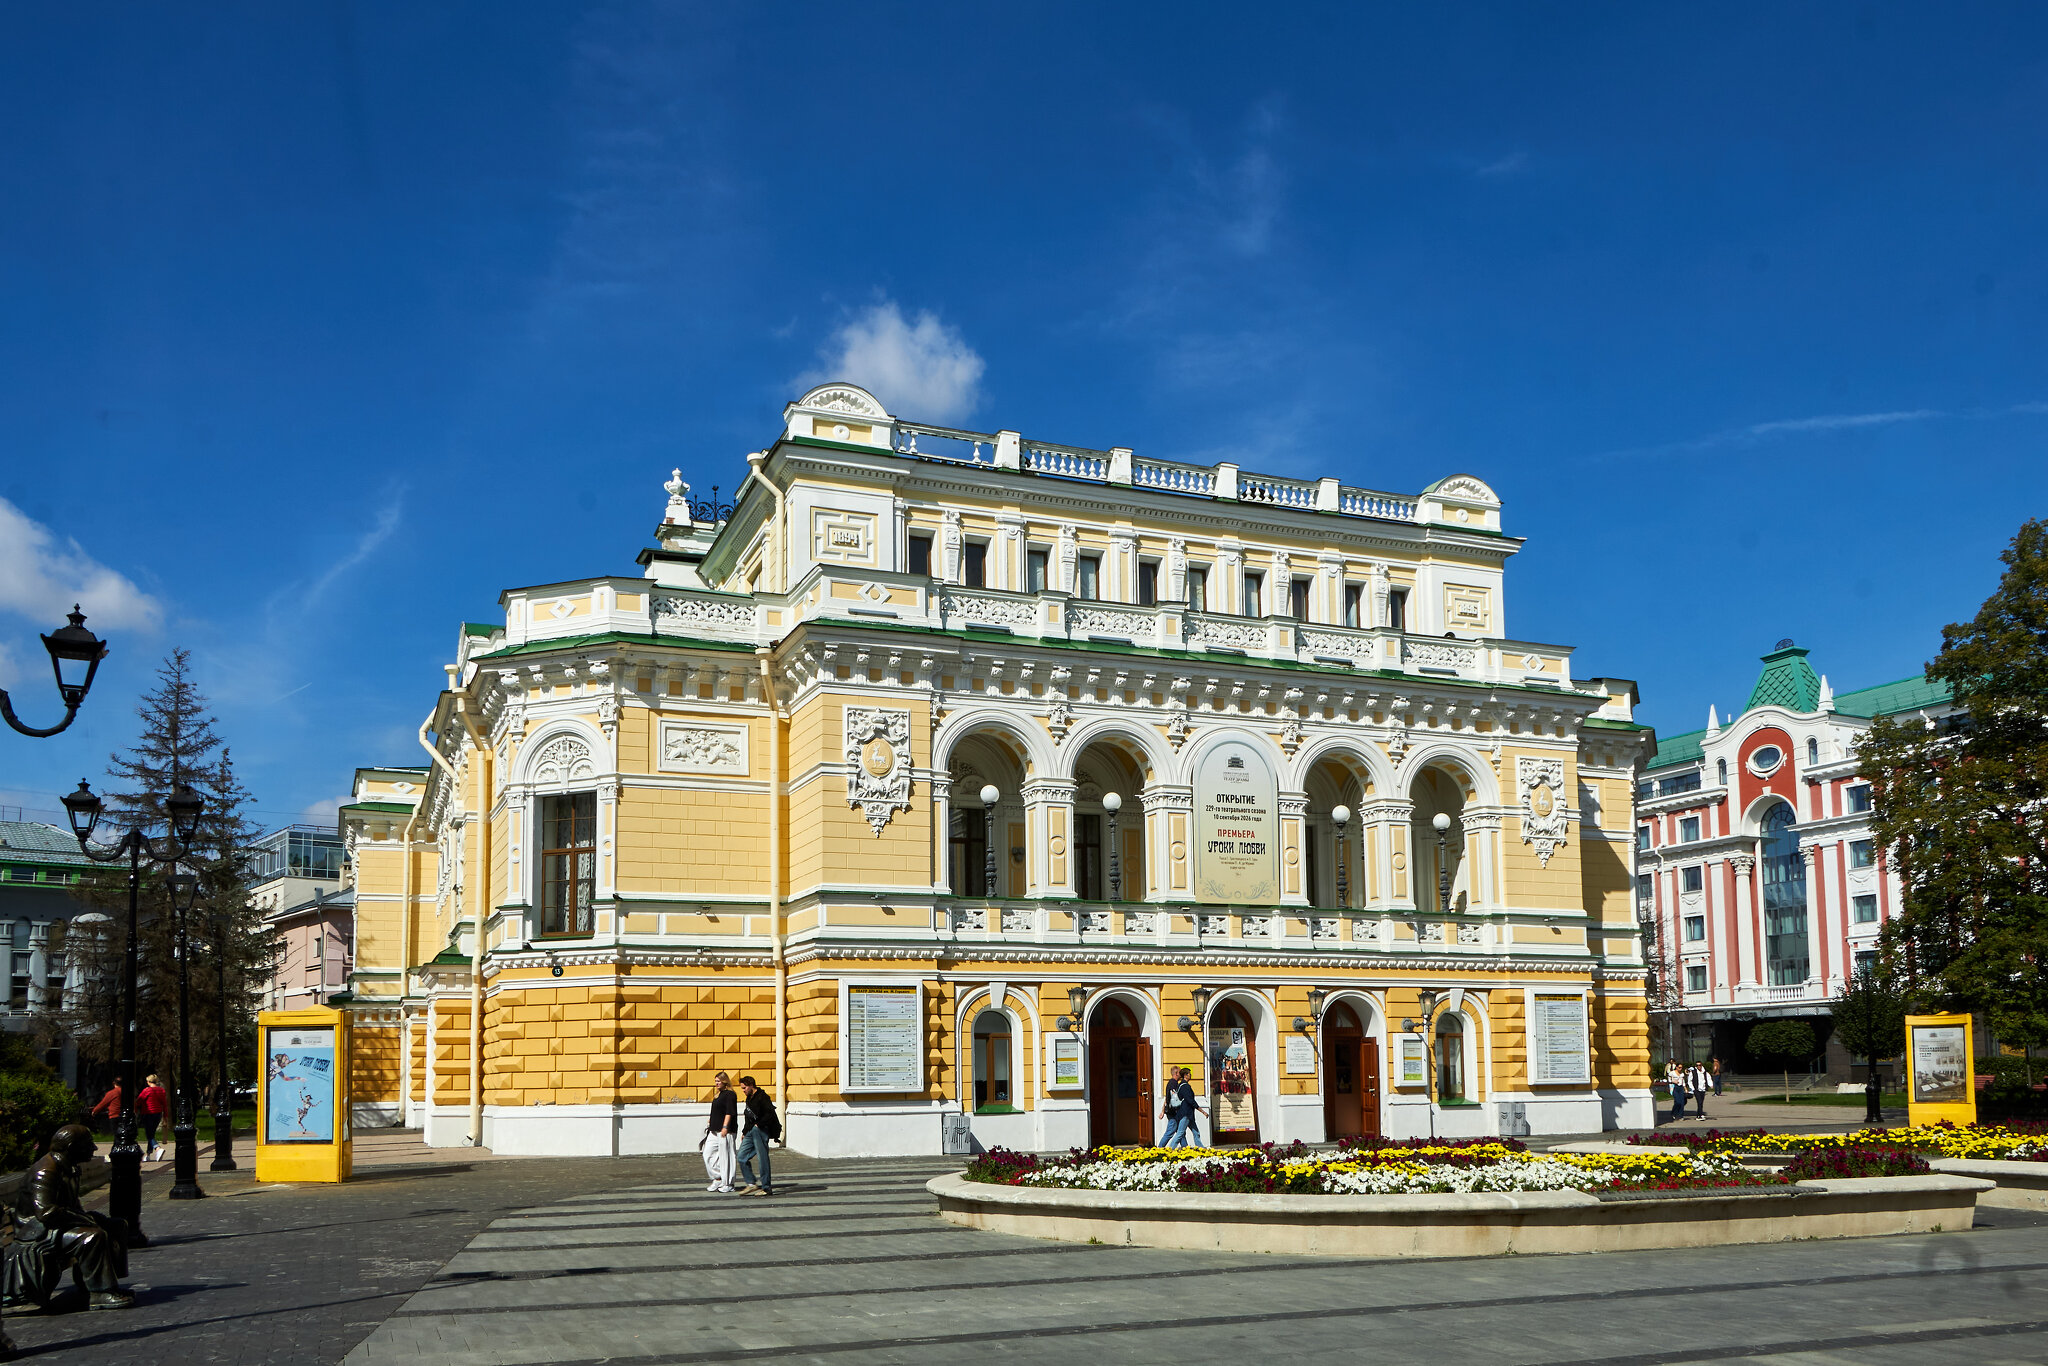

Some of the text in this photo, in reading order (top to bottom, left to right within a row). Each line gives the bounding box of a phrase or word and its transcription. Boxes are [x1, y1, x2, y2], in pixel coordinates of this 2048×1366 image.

[833, 531, 859, 547] 1894
[1216, 794, 1255, 804] ОТКРЫТИЕ
[1218, 829, 1255, 839] ПРЕМЬЕРА
[1208, 841, 1265, 855] УРОКИ ЛЮБВИ
